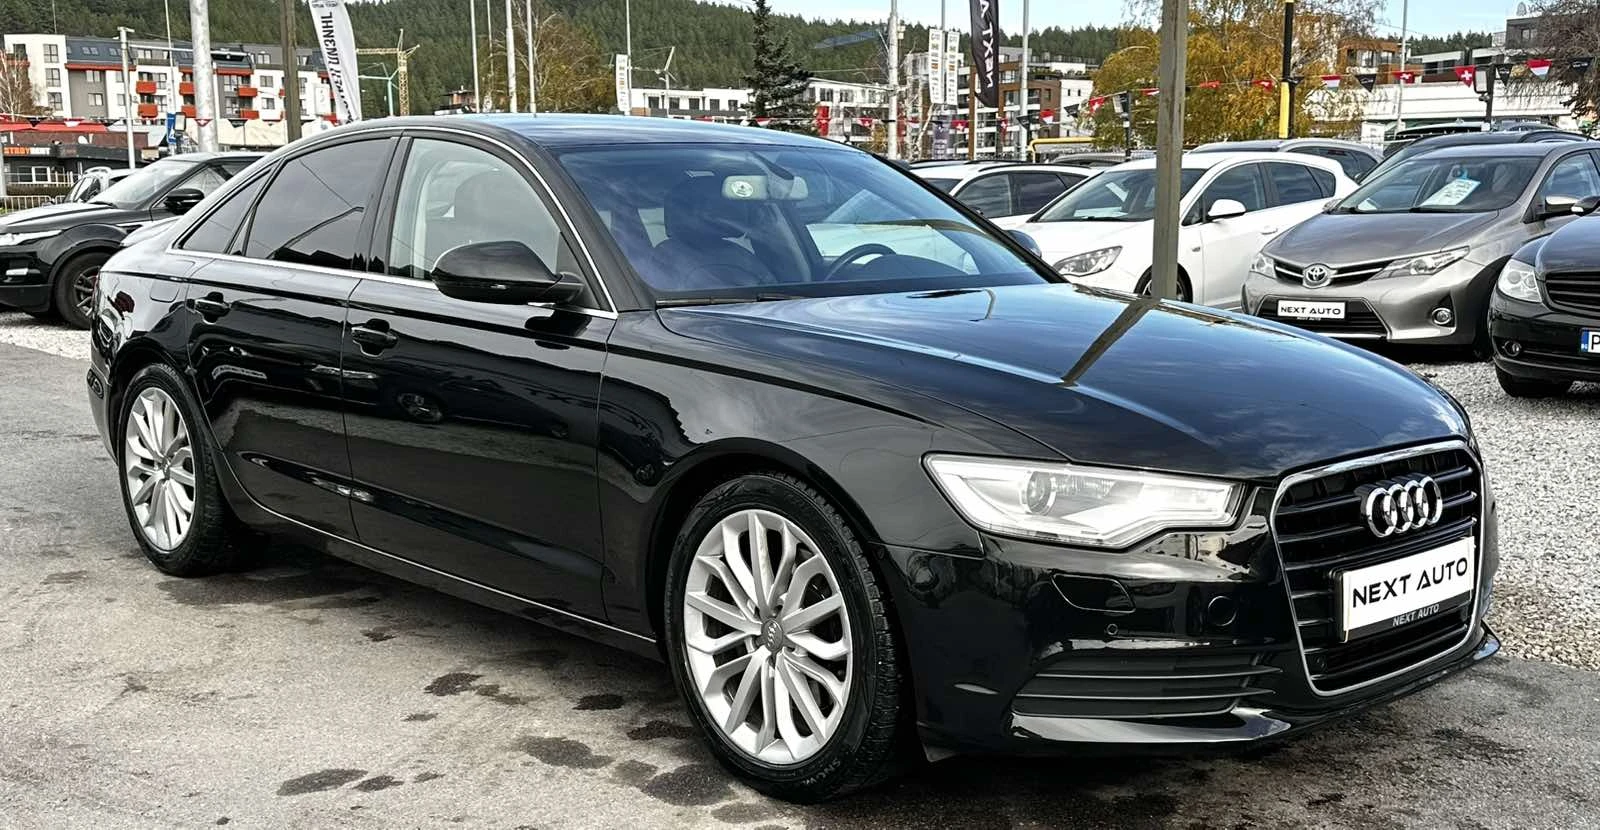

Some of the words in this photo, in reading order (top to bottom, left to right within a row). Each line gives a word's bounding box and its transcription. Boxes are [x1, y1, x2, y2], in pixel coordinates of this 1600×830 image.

[1280, 306, 1307, 314] NEXT
[1309, 307, 1342, 316] AUTO
[1352, 572, 1412, 608] NEXT
[1416, 556, 1469, 591] AUTO
[1391, 611, 1416, 627] NEXT
[1417, 603, 1441, 620] AUTO
